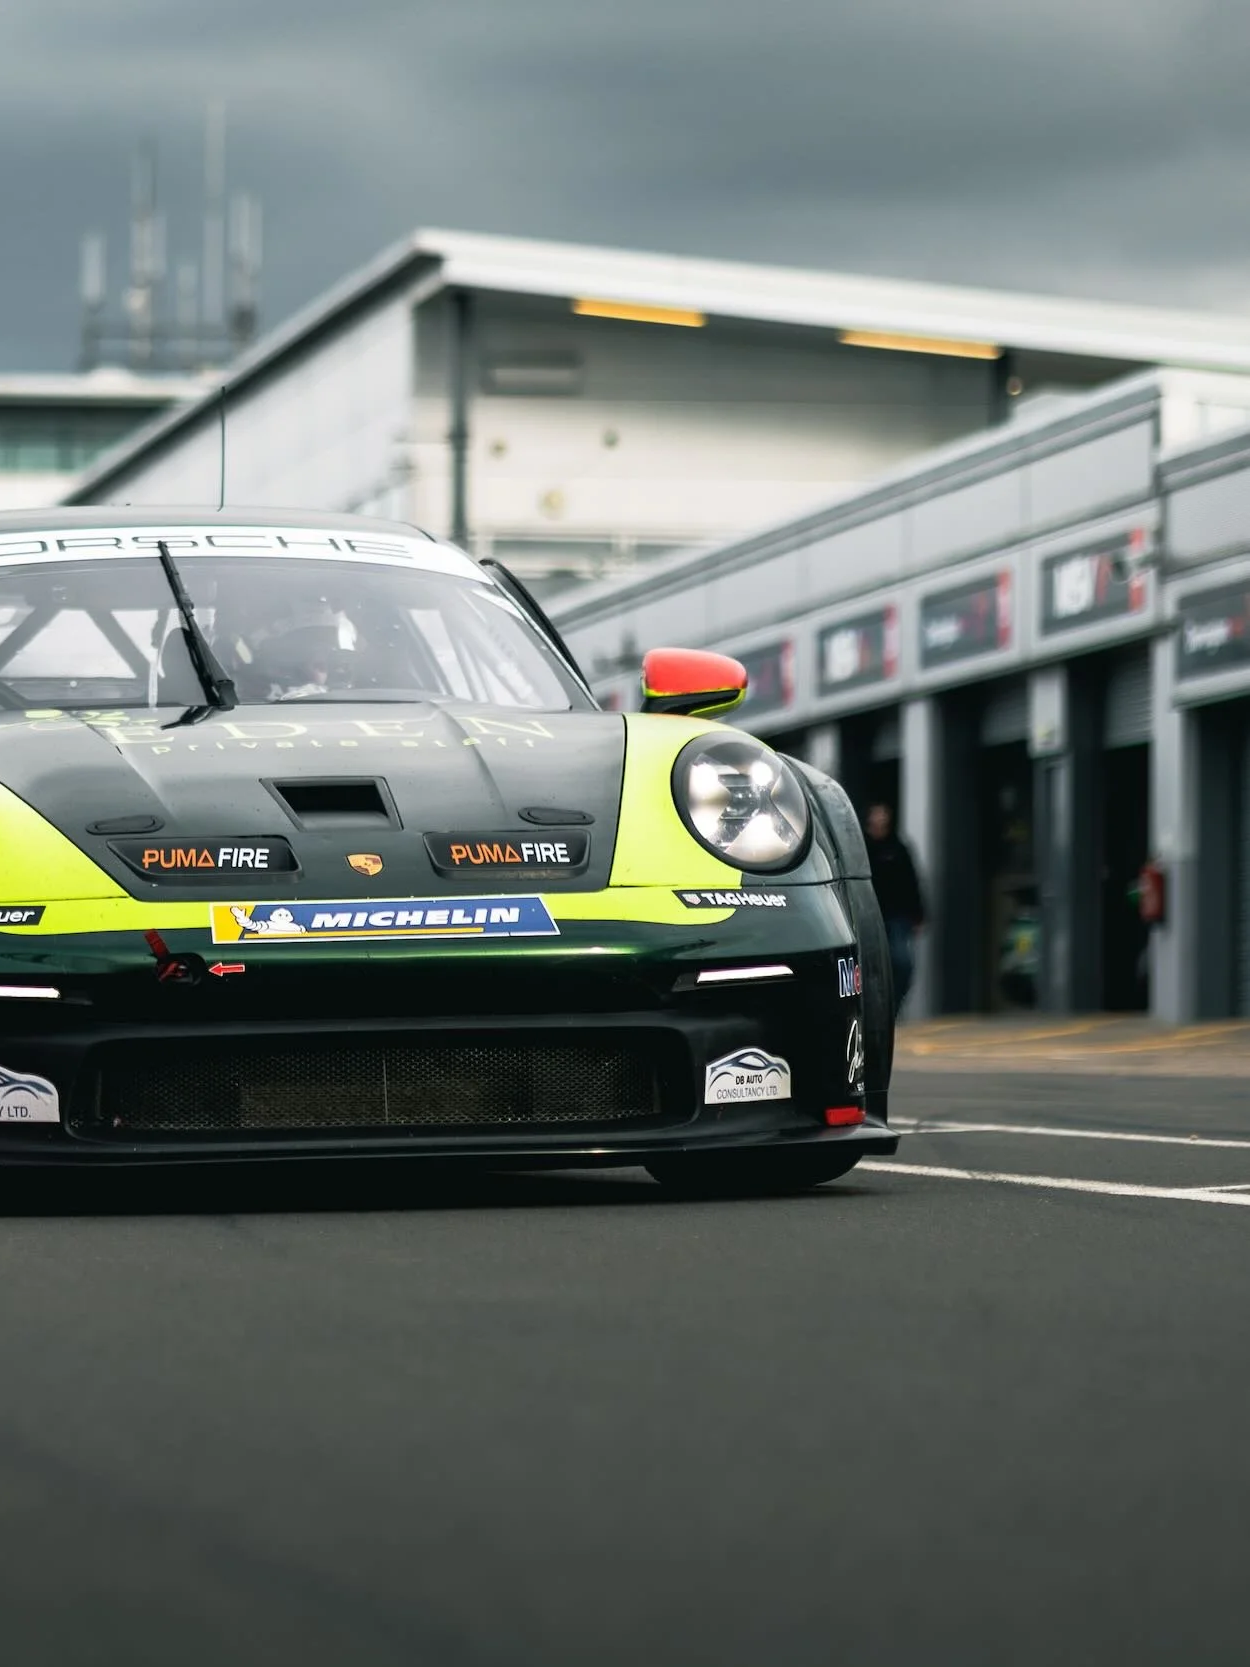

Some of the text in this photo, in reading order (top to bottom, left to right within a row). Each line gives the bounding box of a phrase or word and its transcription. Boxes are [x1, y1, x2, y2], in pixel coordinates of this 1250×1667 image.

[106, 716, 555, 744] EDEN
[310, 907, 521, 929] MICHELIN
[735, 1073, 763, 1085] DB AUTO
[716, 1085, 765, 1100] CONSULTANCY
[7, 1106, 31, 1118] LTD.
